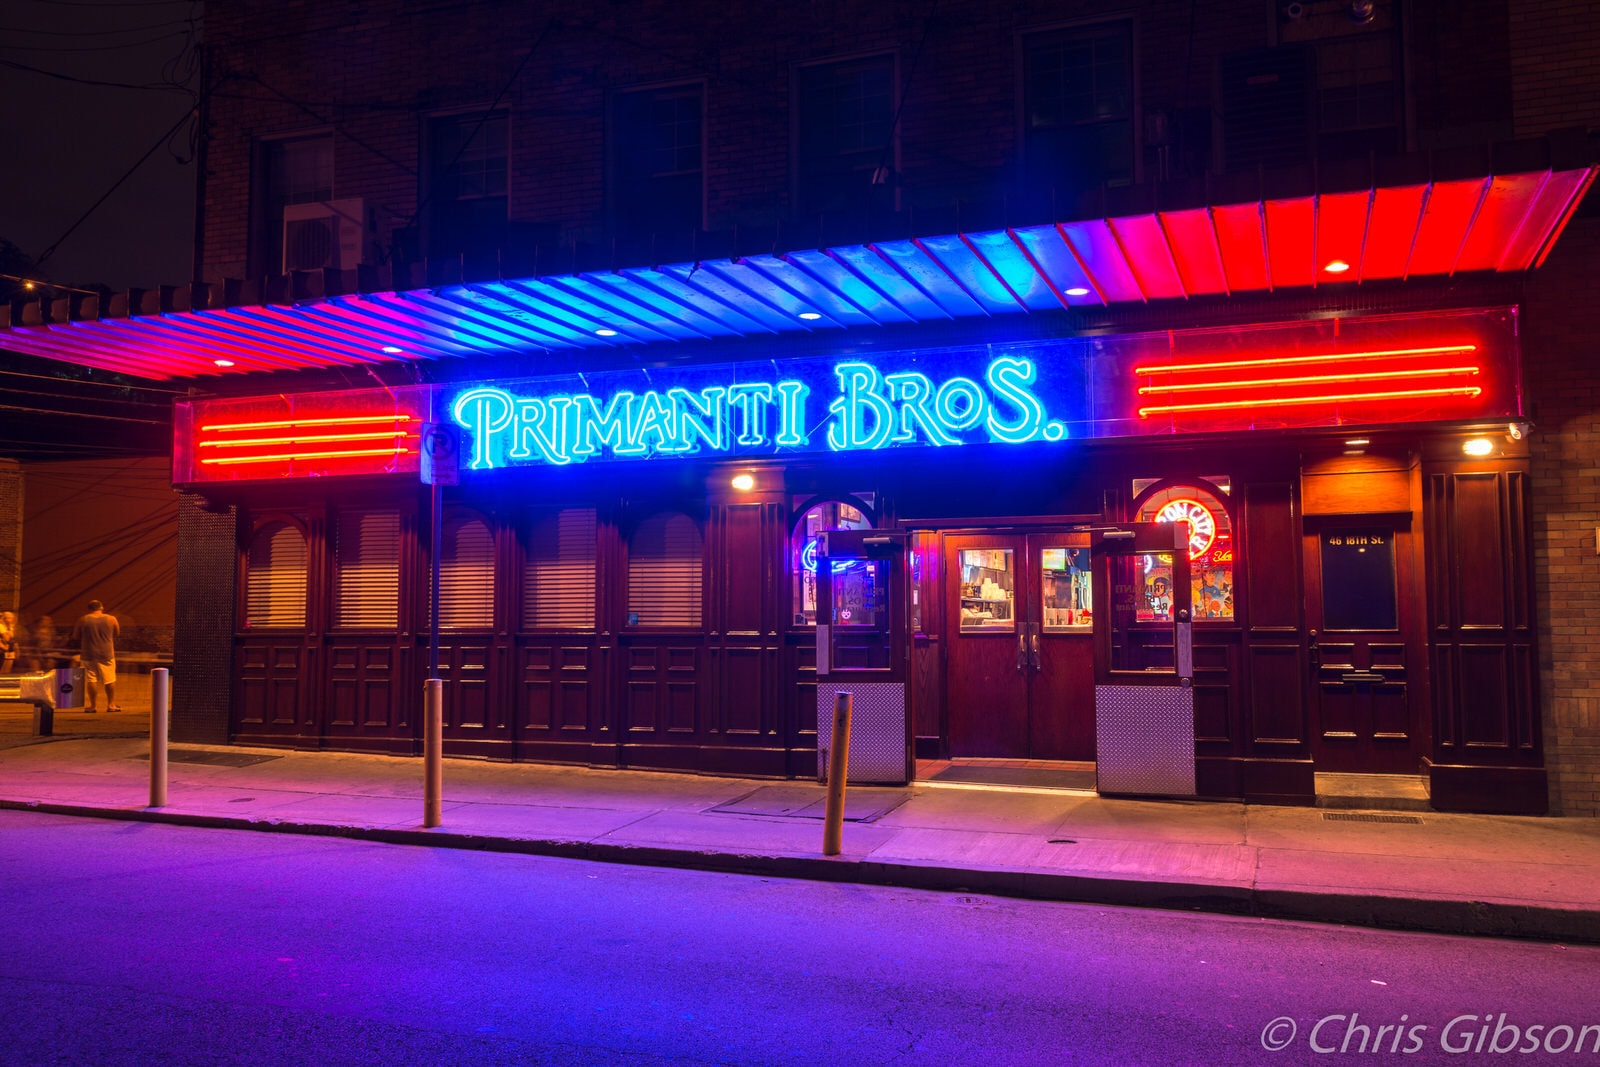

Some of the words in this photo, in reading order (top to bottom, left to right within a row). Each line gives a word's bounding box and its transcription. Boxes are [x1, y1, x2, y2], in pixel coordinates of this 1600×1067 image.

[451, 384, 806, 470] PRIMANTI
[828, 357, 1065, 451] BROS.
[1189, 506, 1212, 536] CITY
[1329, 535, 1342, 545] 46
[1345, 535, 1367, 545] 18TH
